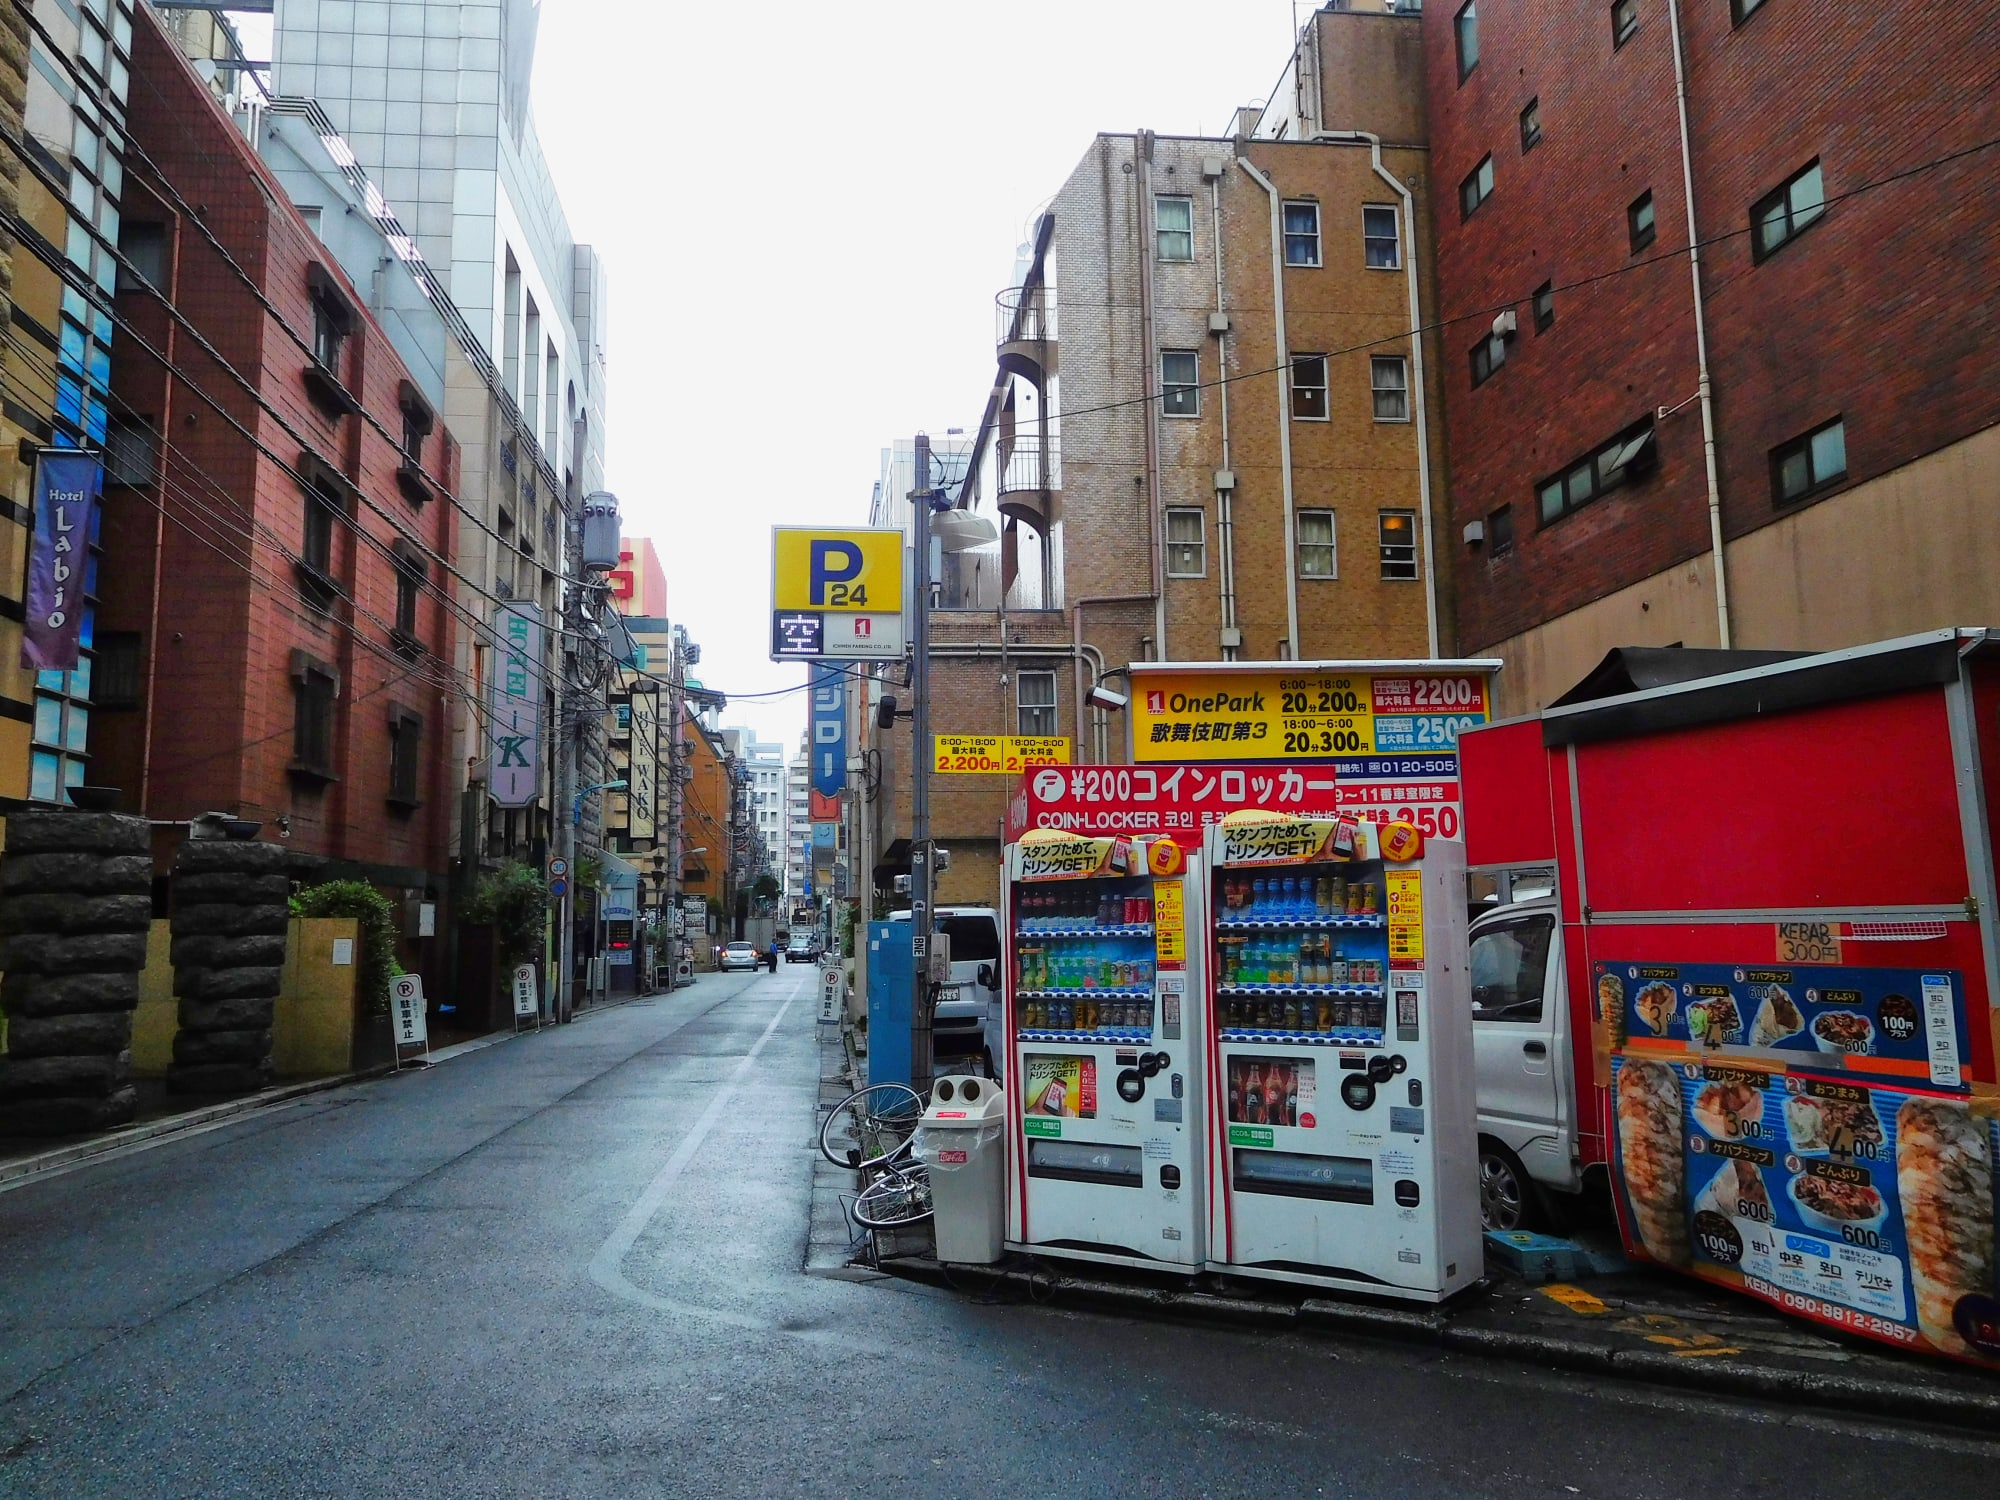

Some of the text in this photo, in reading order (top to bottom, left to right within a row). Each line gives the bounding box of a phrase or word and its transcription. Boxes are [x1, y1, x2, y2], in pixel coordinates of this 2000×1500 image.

[49, 489, 84, 501] Hotel
[47, 505, 74, 629] Labio
[809, 539, 864, 606] P
[830, 583, 868, 606] 24
[780, 614, 819, 653] 空
[1169, 691, 1266, 713] OnePark
[1149, 721, 1268, 743] 歌舞伎町第3
[938, 756, 1000, 771] 2,200円
[637, 764, 650, 820] WAKO
[1037, 811, 1160, 829] COIN-LOCKER
[1164, 811, 1194, 828] 코인
[1224, 823, 1316, 842] スタンプためて、
[1021, 841, 1097, 859] スタンプためて、
[1225, 839, 1316, 860] ドリンクGET!
[552, 863, 566, 872] 30
[1022, 857, 1097, 875] ドリンクGET!
[1778, 923, 1831, 945] KEBAB
[914, 937, 924, 956] BNE
[1783, 941, 1839, 963] 300円
[1882, 1016, 1914, 1030] 100円
[1814, 1084, 1861, 1100] おつまみ
[1815, 1163, 1860, 1181] どんぶり
[1700, 1233, 1739, 1255] 100円
[1751, 1240, 1770, 1255] 甘口
[1791, 1238, 1825, 1255] ソース
[1779, 1251, 1804, 1266] 中辛
[1819, 1261, 1842, 1276] 辛口
[1855, 1270, 1894, 1289] テリヤキ
[1744, 1274, 1780, 1302] KEBAB
[1784, 1293, 1917, 1343] 090-8812-2957
